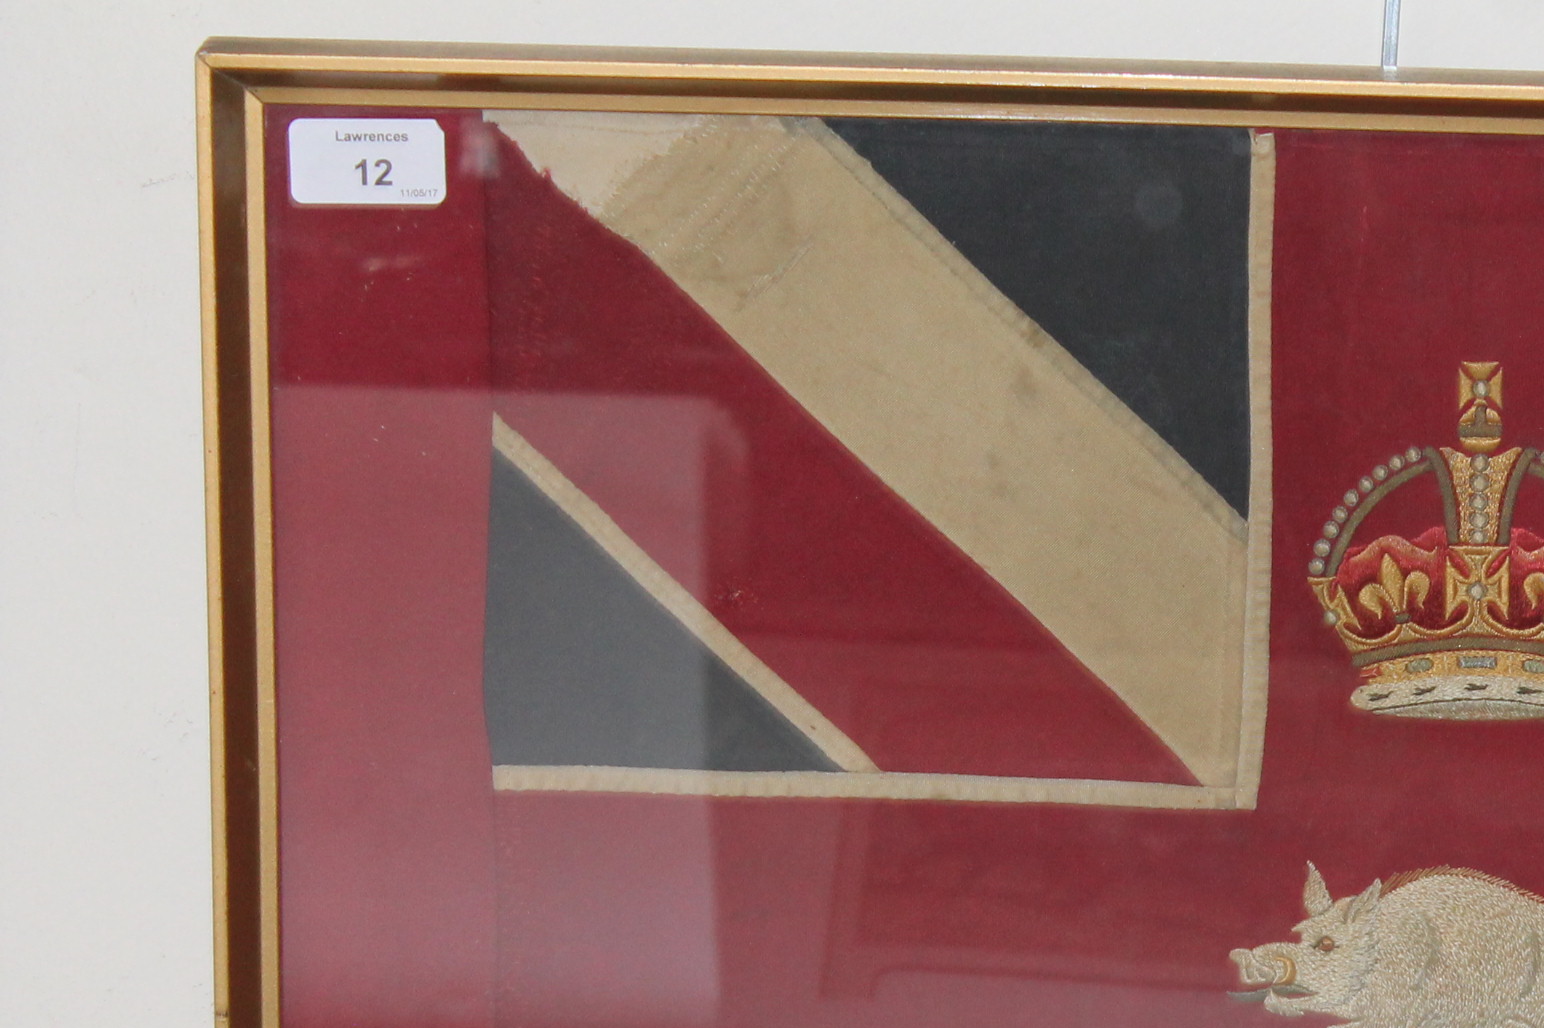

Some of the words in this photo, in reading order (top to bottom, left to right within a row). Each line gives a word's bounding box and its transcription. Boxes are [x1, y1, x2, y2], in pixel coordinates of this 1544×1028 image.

[335, 131, 409, 142] Lawrences
[355, 159, 393, 186] 12
[400, 189, 438, 197] 11/05/17
